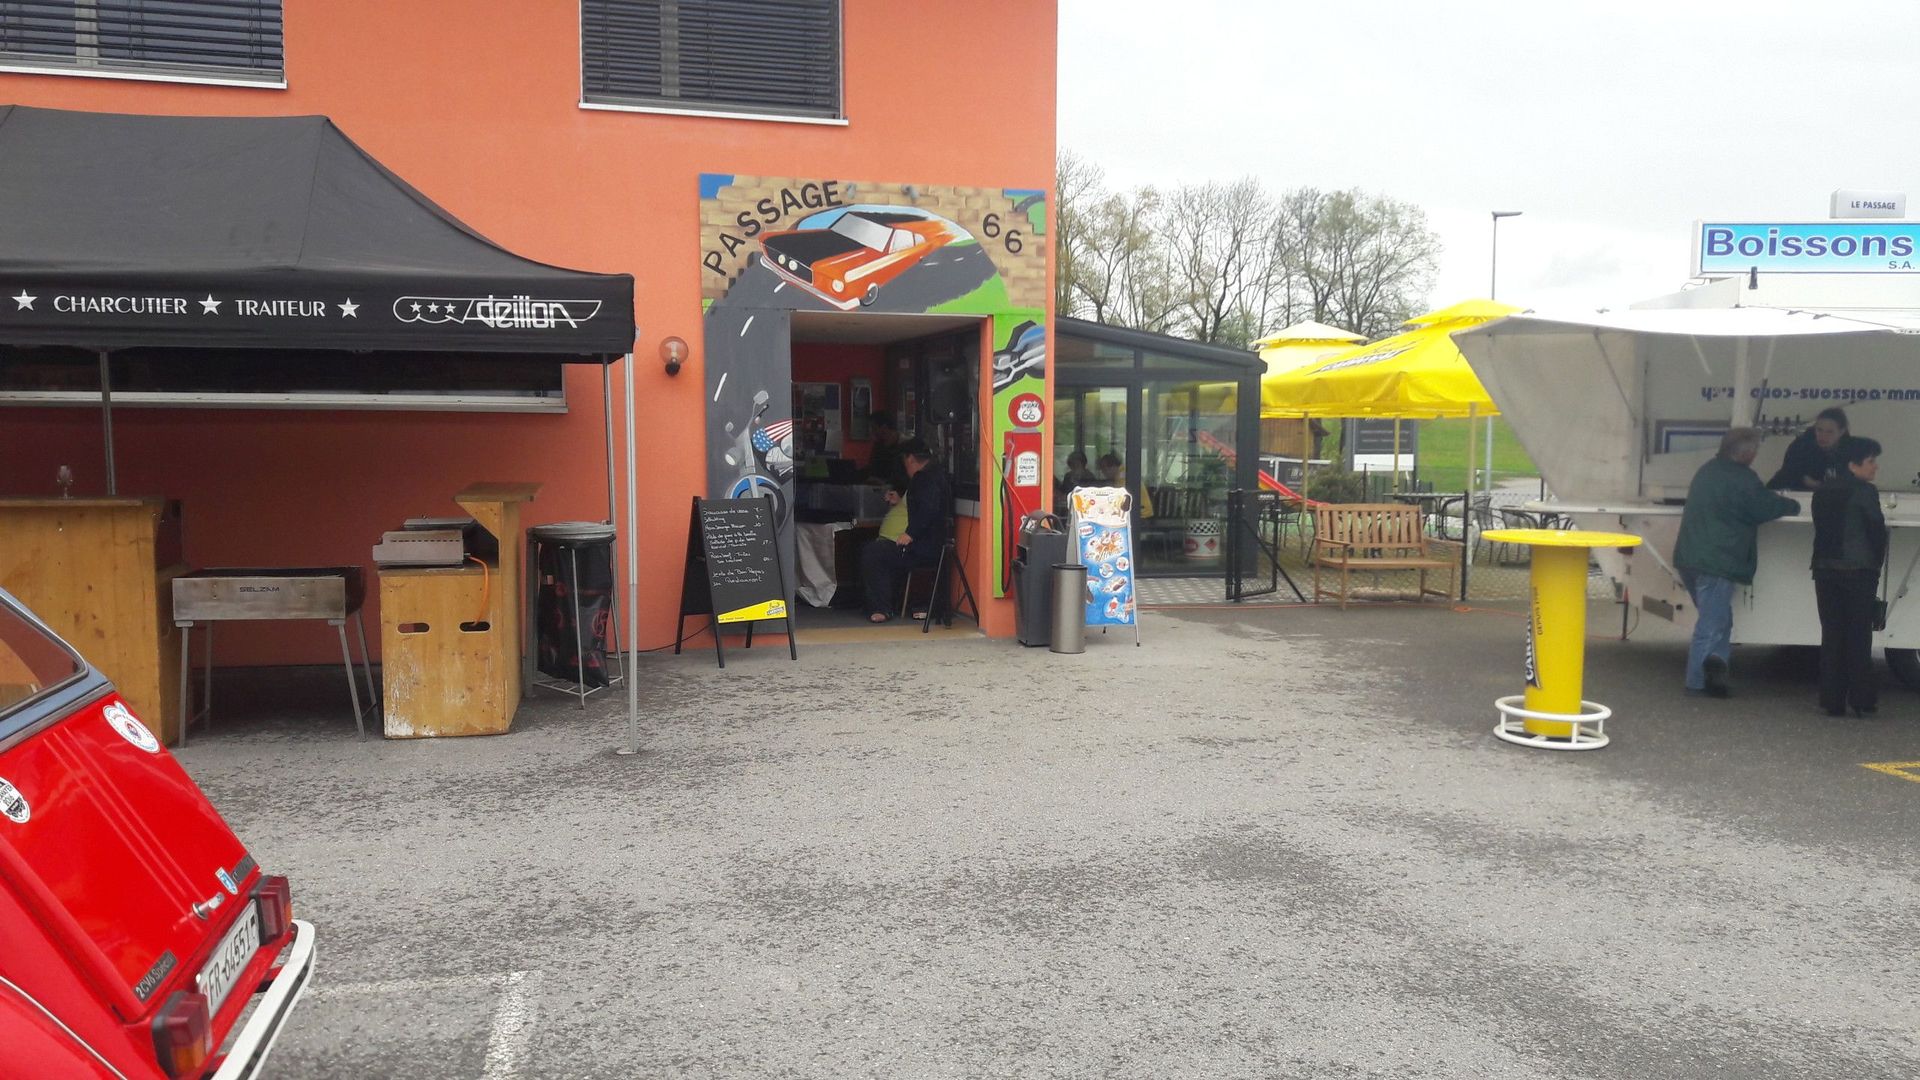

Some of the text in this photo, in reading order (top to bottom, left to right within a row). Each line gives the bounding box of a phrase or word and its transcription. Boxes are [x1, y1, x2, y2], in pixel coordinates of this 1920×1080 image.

[1851, 200, 1896, 210] LE PASSAGE
[703, 180, 842, 276] PASSAGE
[1707, 228, 1913, 257] Boissons
[1888, 260, 1915, 270] S.A.
[54, 295, 326, 318] CHARCUTIER TRAITEUR
[1022, 410, 1035, 420] 66
